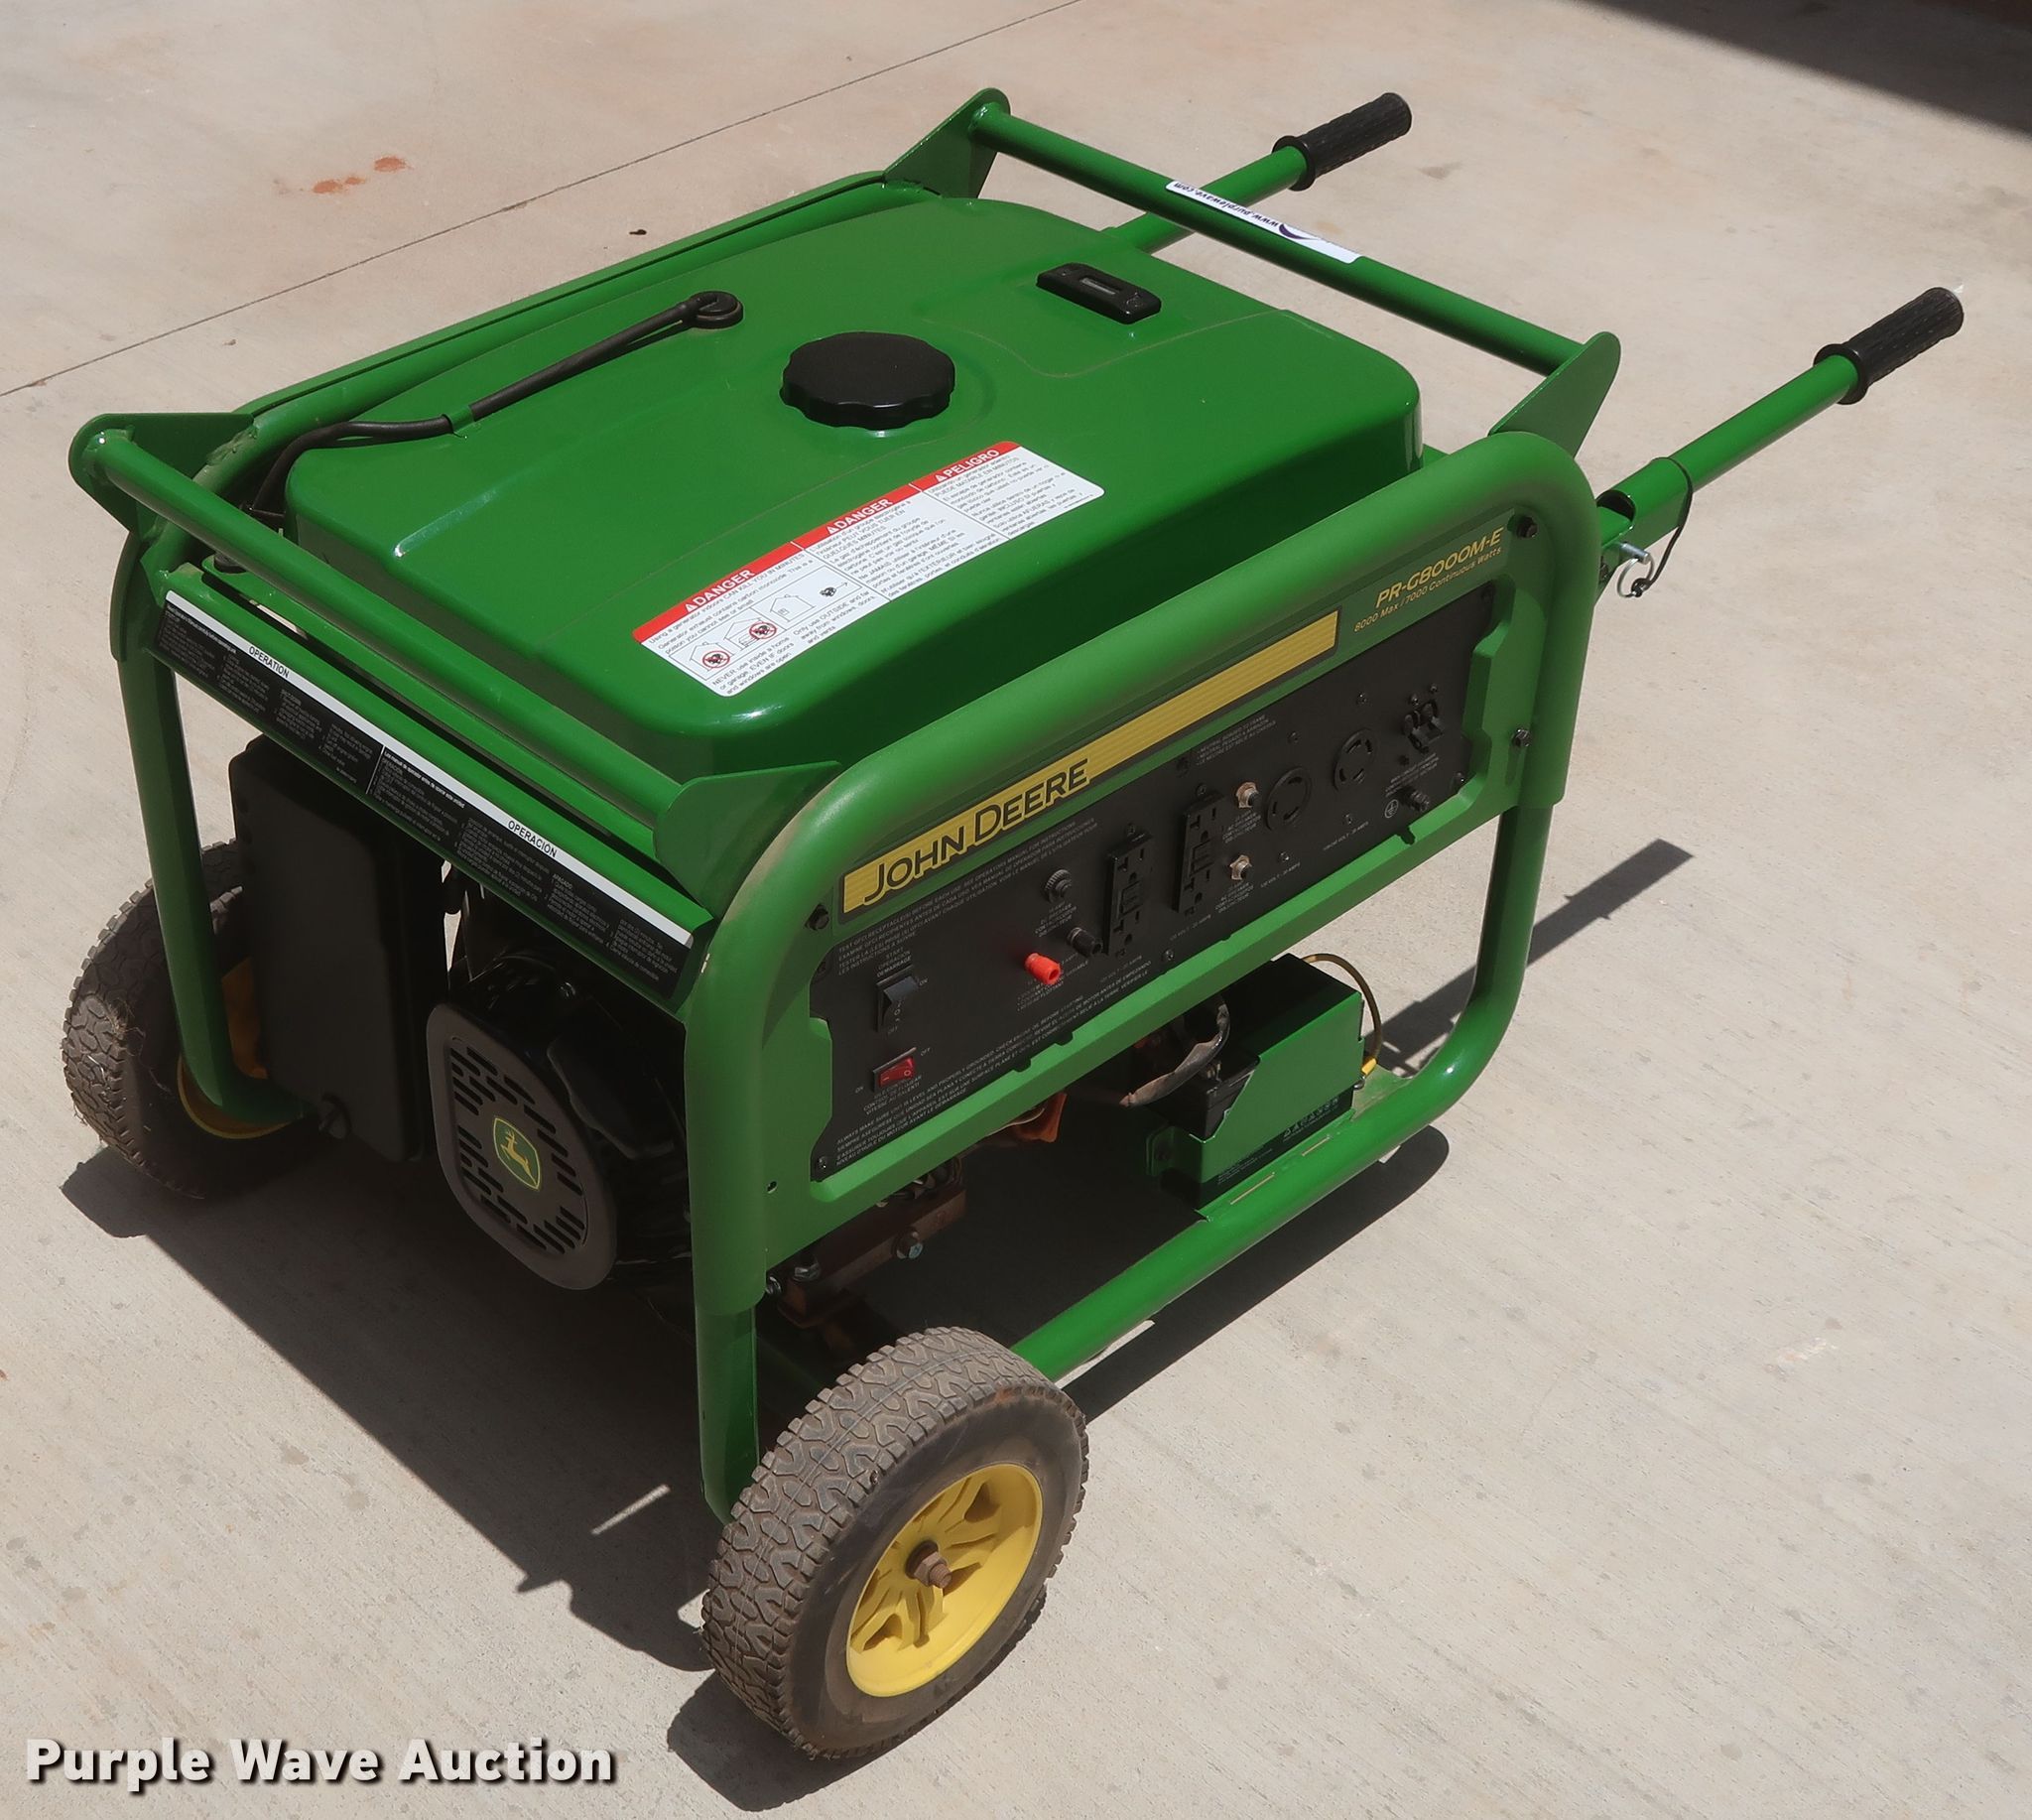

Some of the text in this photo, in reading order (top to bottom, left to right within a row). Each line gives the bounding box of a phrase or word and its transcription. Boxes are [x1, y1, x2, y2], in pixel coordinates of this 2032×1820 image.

[1174, 183, 1278, 227] www.purplewave.com
[941, 449, 1001, 476] PELIGRO
[832, 498, 893, 529] DANGER
[691, 569, 755, 605] DANGER
[1375, 527, 1505, 608] PR-G8000M-E
[1354, 614, 1379, 632] 8000
[1380, 604, 1398, 618] Max
[1406, 585, 1428, 603] 7000
[1429, 563, 1475, 590] Continuous
[1477, 547, 1501, 565] Watts
[248, 645, 289, 679] OPERATION
[507, 818, 557, 857] OPERACIÓN
[864, 758, 1088, 903] JOHN DEERE
